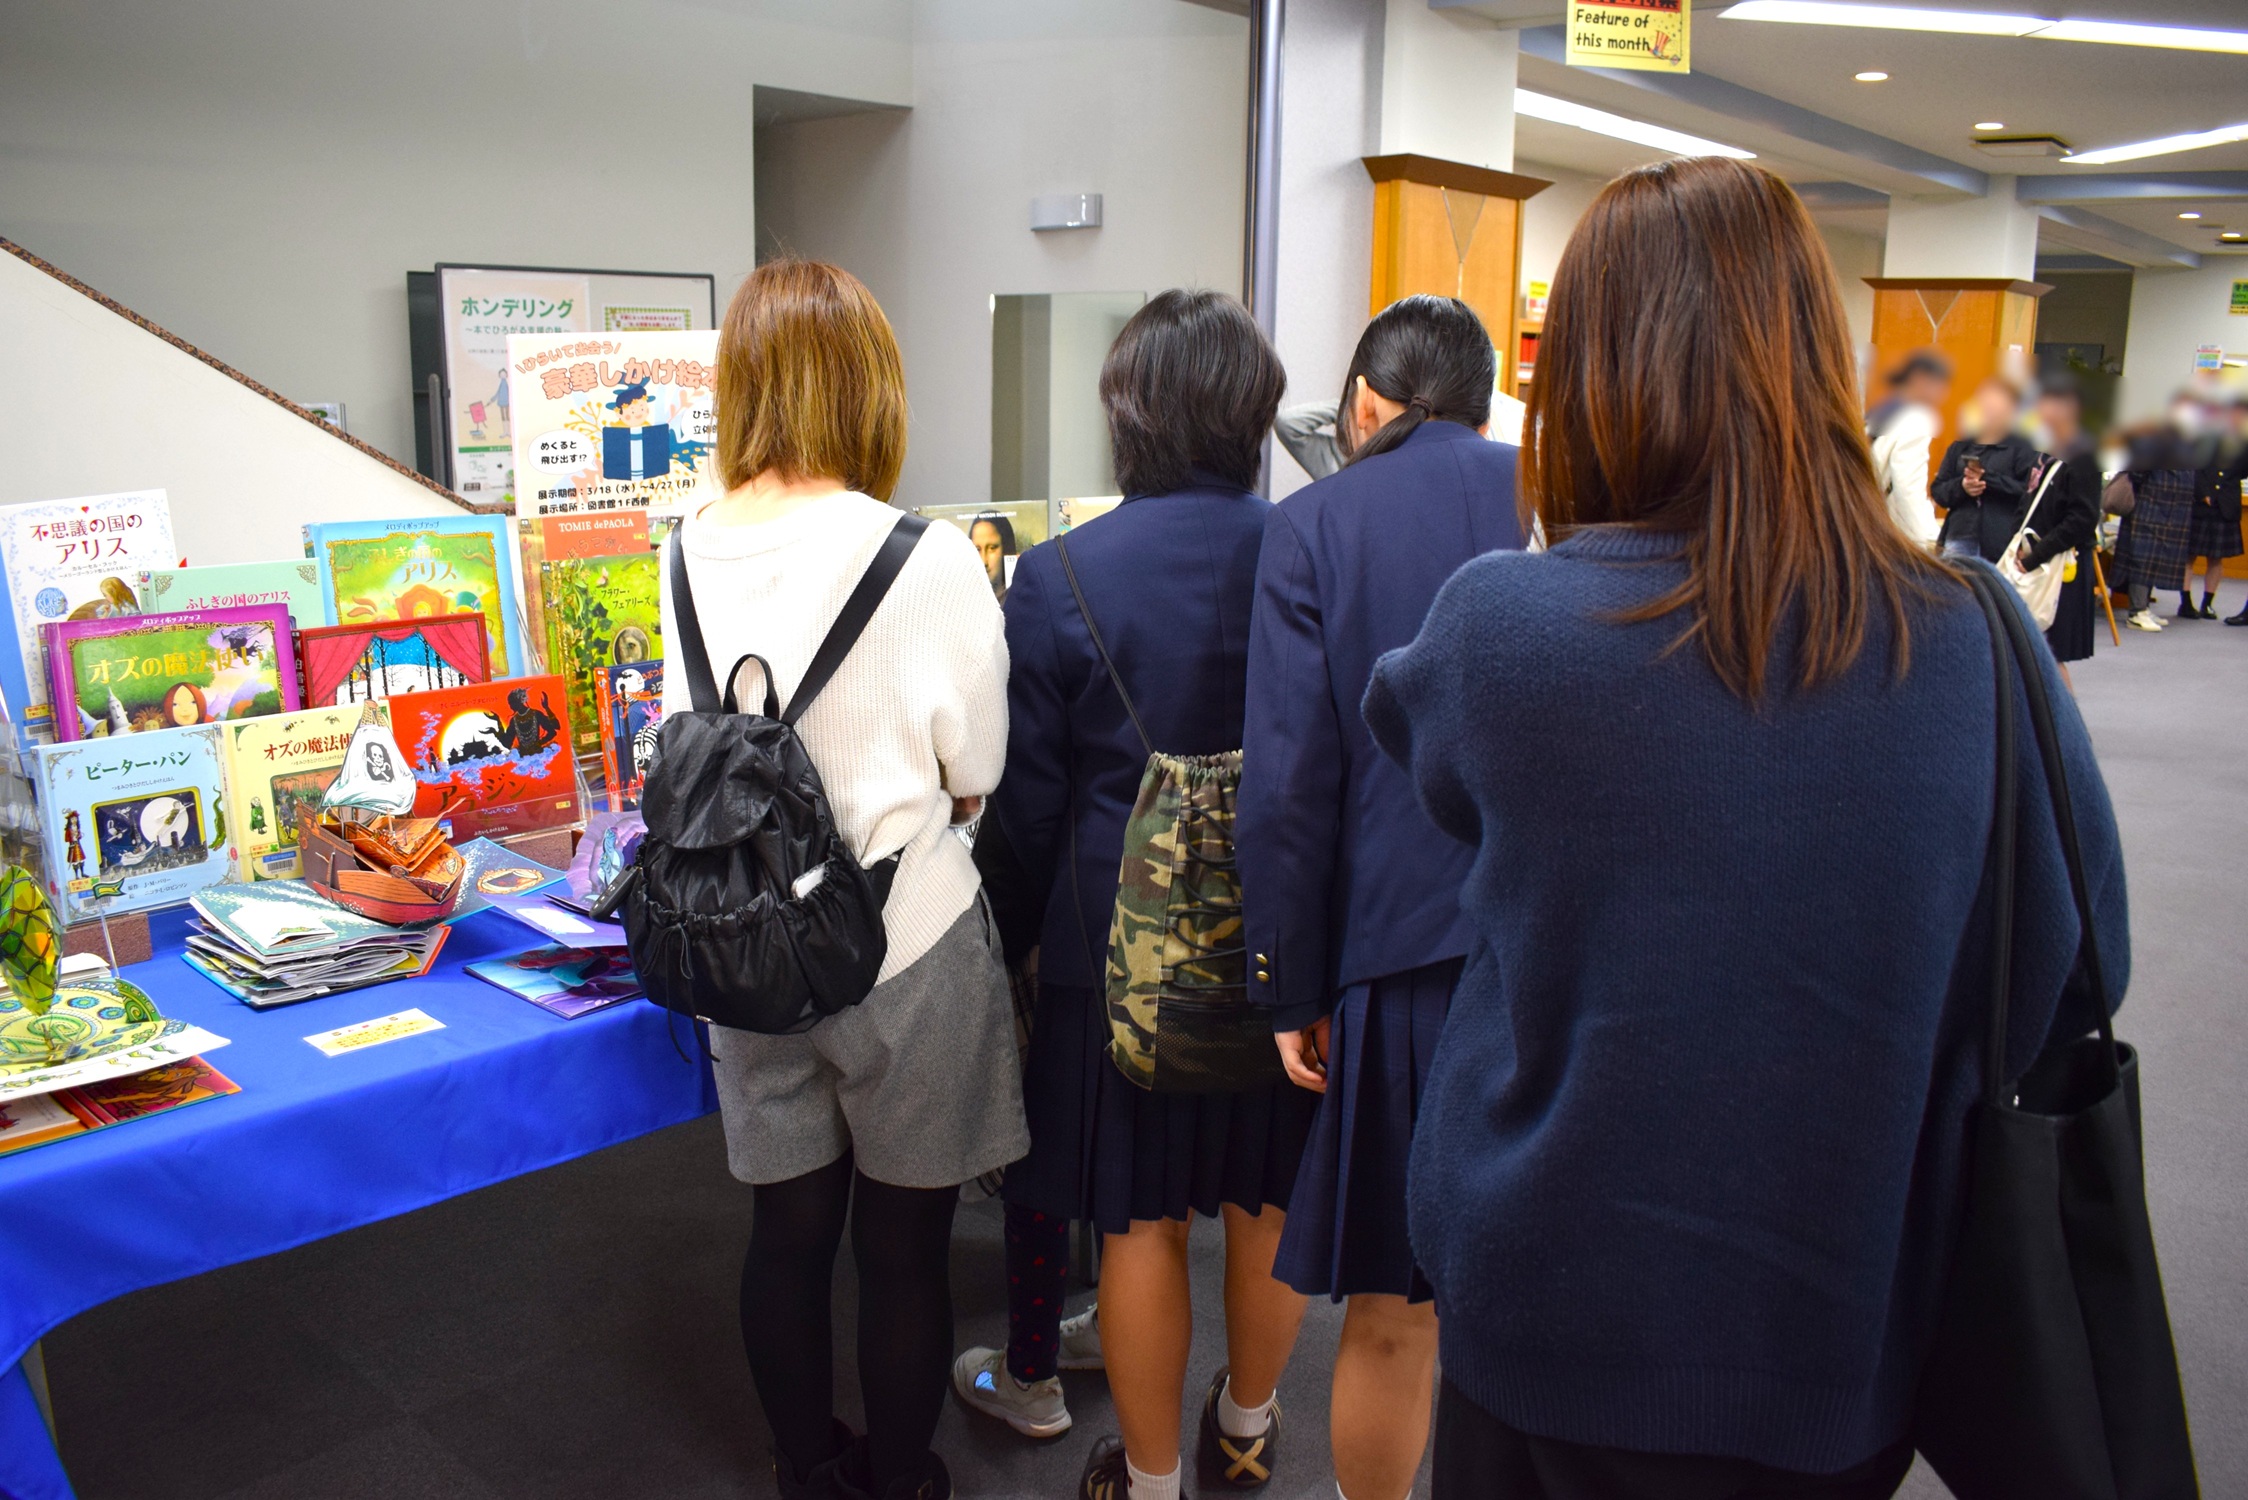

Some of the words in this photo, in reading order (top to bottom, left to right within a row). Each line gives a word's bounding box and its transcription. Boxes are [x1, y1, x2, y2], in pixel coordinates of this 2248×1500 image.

[1576, 9, 1630, 27] Feature
[1634, 14, 1650, 28] of
[1576, 32, 1602, 48] this
[1607, 36, 1650, 51] month
[461, 297, 574, 319] ホンデリング
[541, 441, 577, 450] めくると
[30, 514, 142, 541] 不思議の国の
[558, 521, 592, 532] TOMIE
[594, 518, 634, 529] dePAOLA
[56, 538, 128, 564] アリス
[402, 560, 457, 584] アリス
[186, 591, 291, 610] ふしぎの国のアリス
[612, 594, 652, 610] フェアリーズ
[88, 646, 264, 684] オズの魔法使い
[86, 751, 192, 780] ピーター・パン
